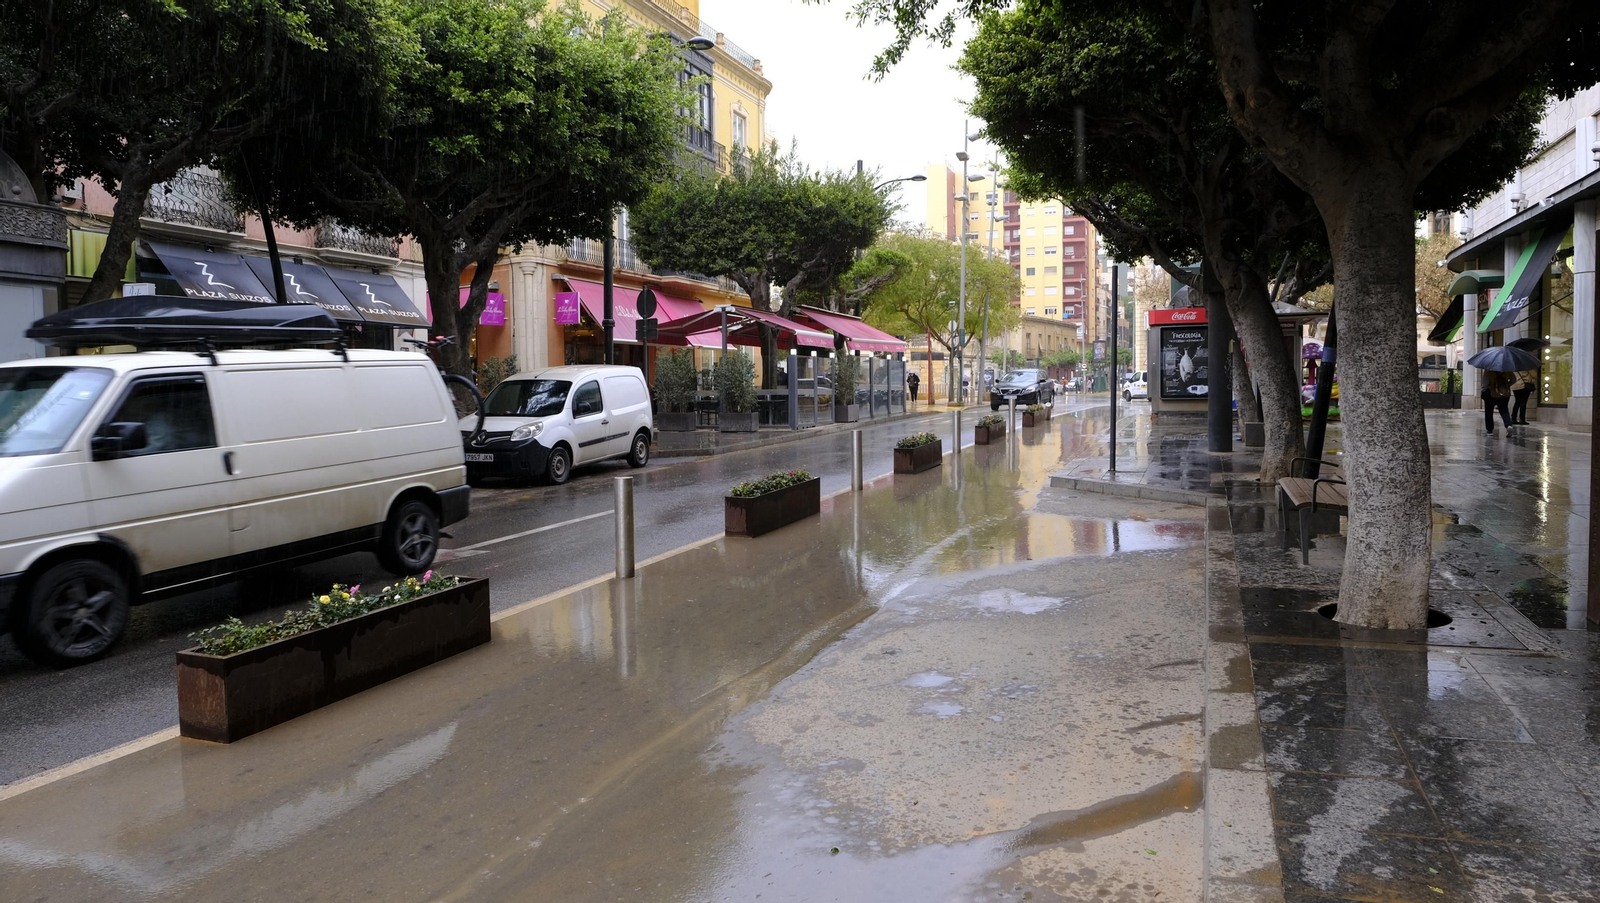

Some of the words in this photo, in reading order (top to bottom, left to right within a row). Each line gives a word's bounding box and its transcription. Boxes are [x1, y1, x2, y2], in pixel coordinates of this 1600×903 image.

[185, 288, 227, 299] PLAZA
[228, 292, 272, 303] SUIZOS
[315, 302, 351, 311] SUIZOS
[358, 306, 388, 315] PLAZA
[388, 309, 420, 318] SUIZOS
[1171, 311, 1198, 321] Coca-Cola
